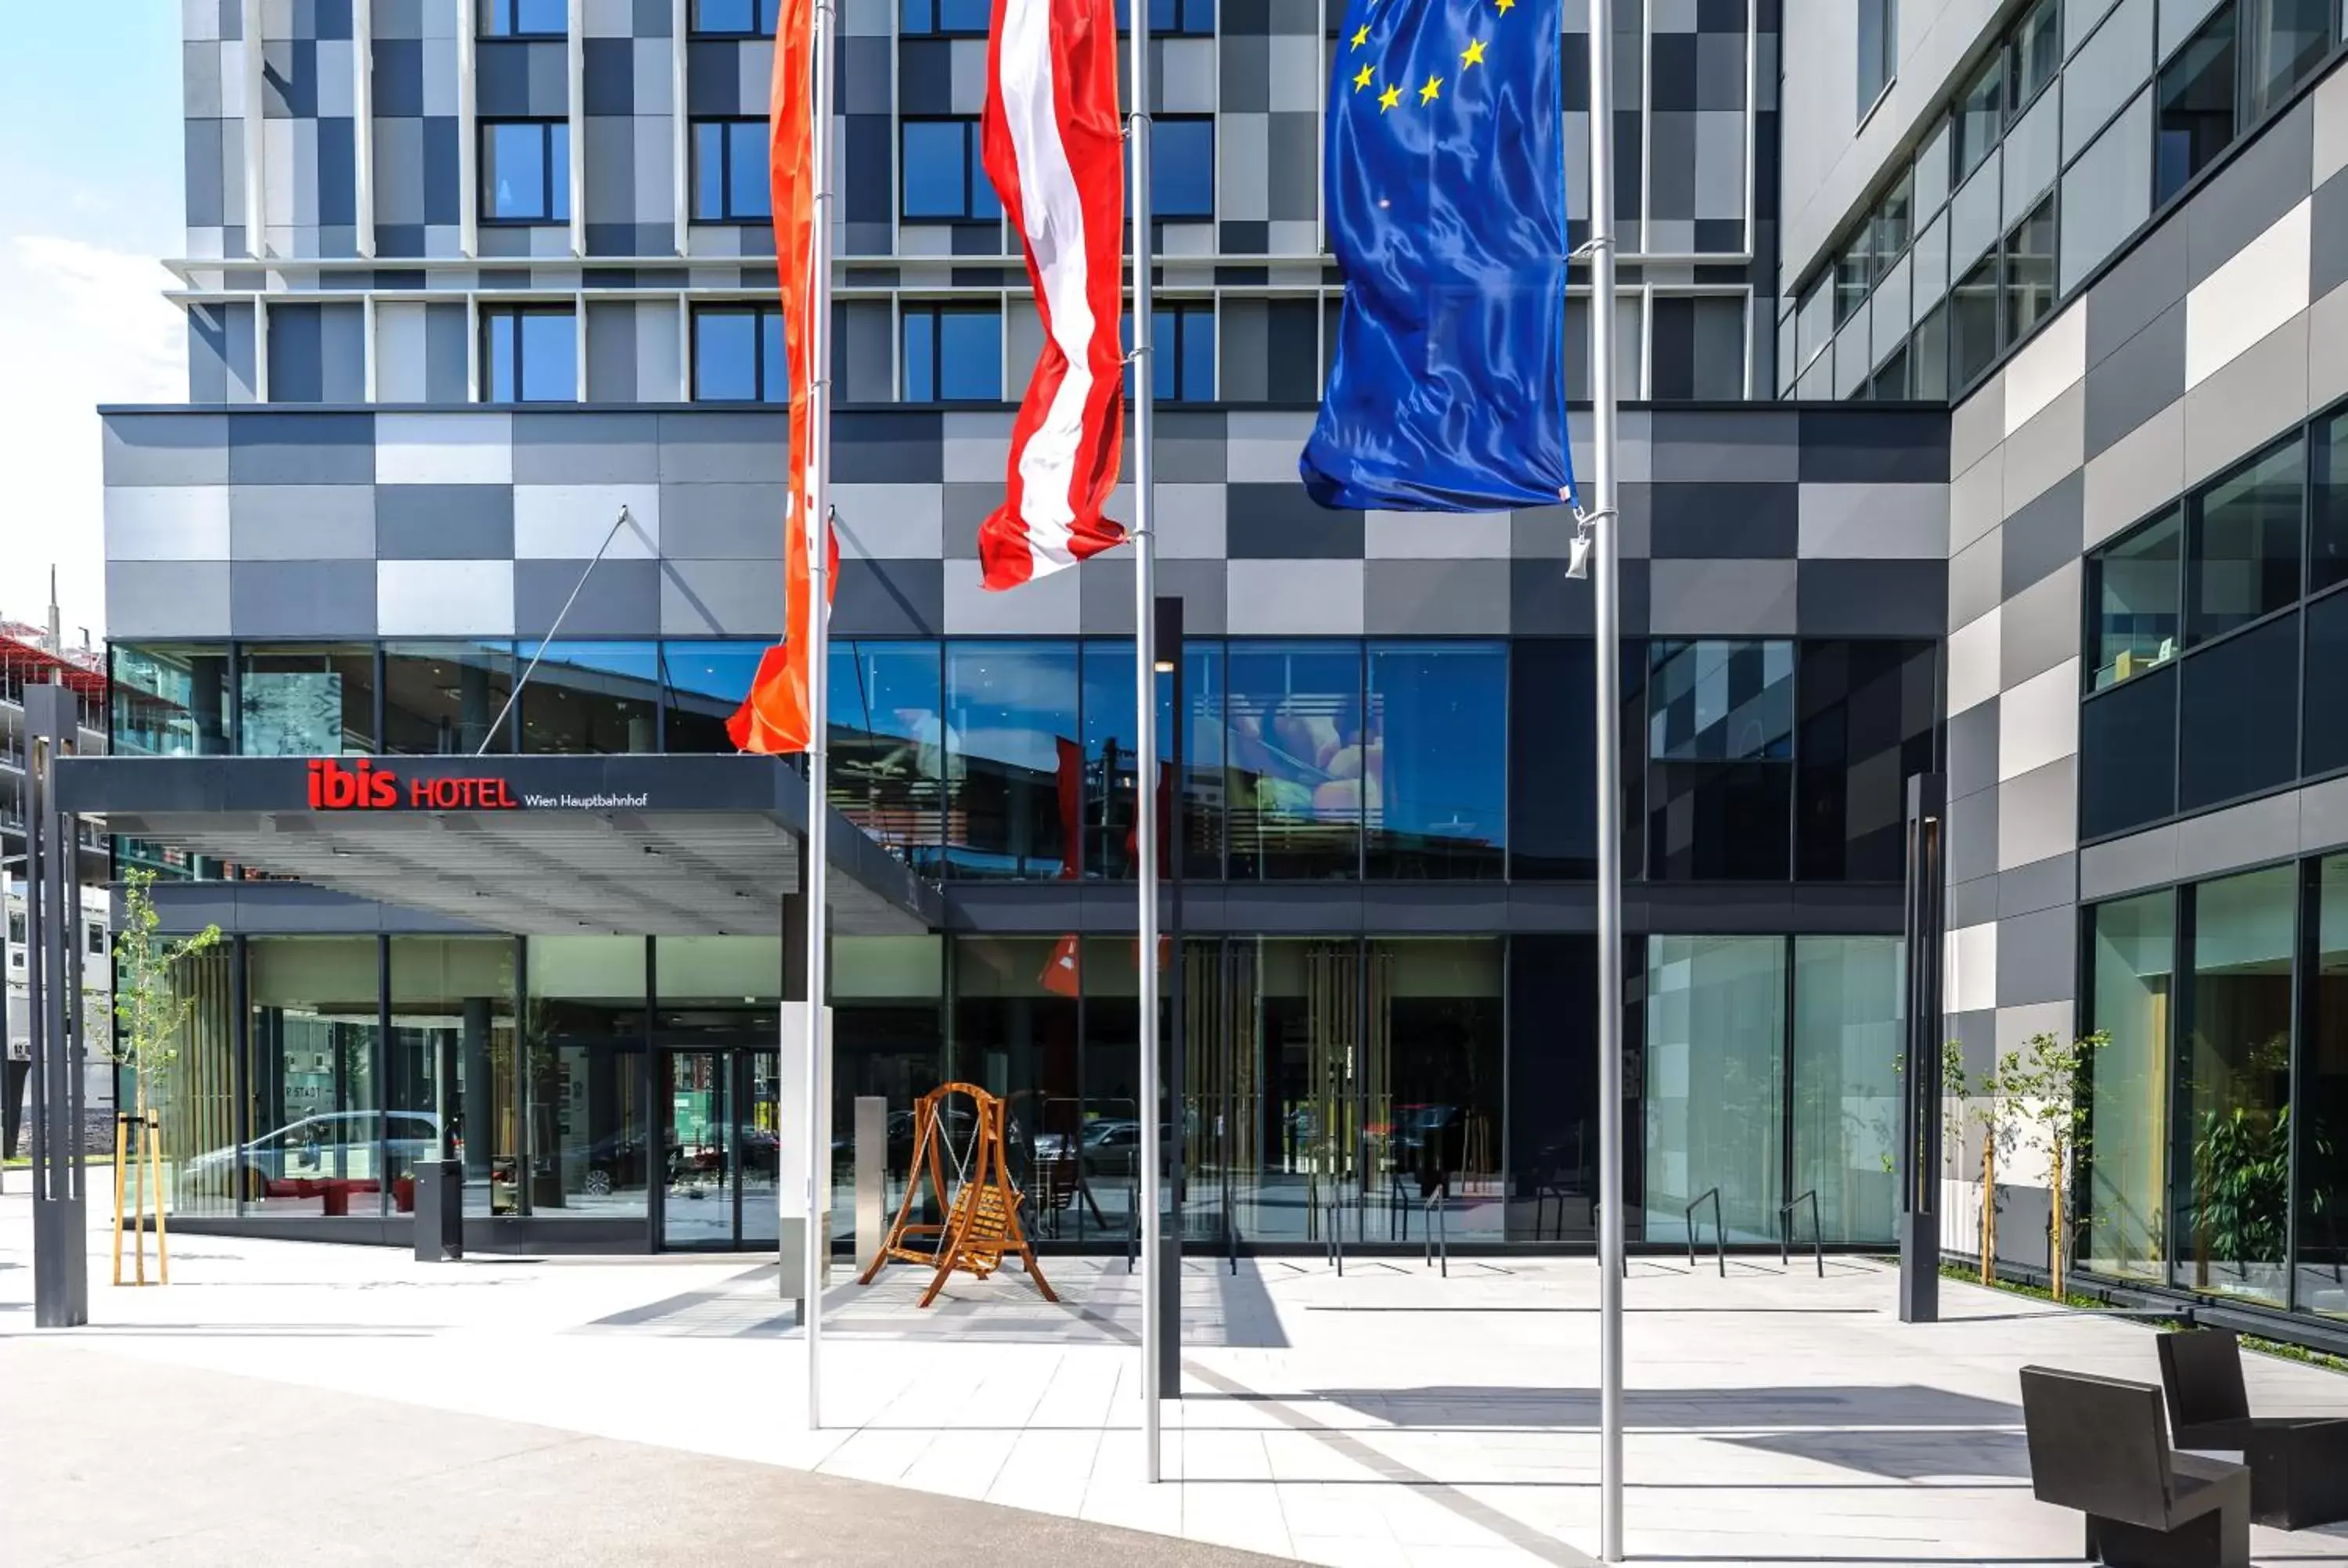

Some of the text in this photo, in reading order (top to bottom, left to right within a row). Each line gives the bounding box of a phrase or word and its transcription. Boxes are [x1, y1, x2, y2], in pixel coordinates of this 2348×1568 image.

[308, 757, 648, 809] ibis HOTEL Wien Hauptbahnhof
